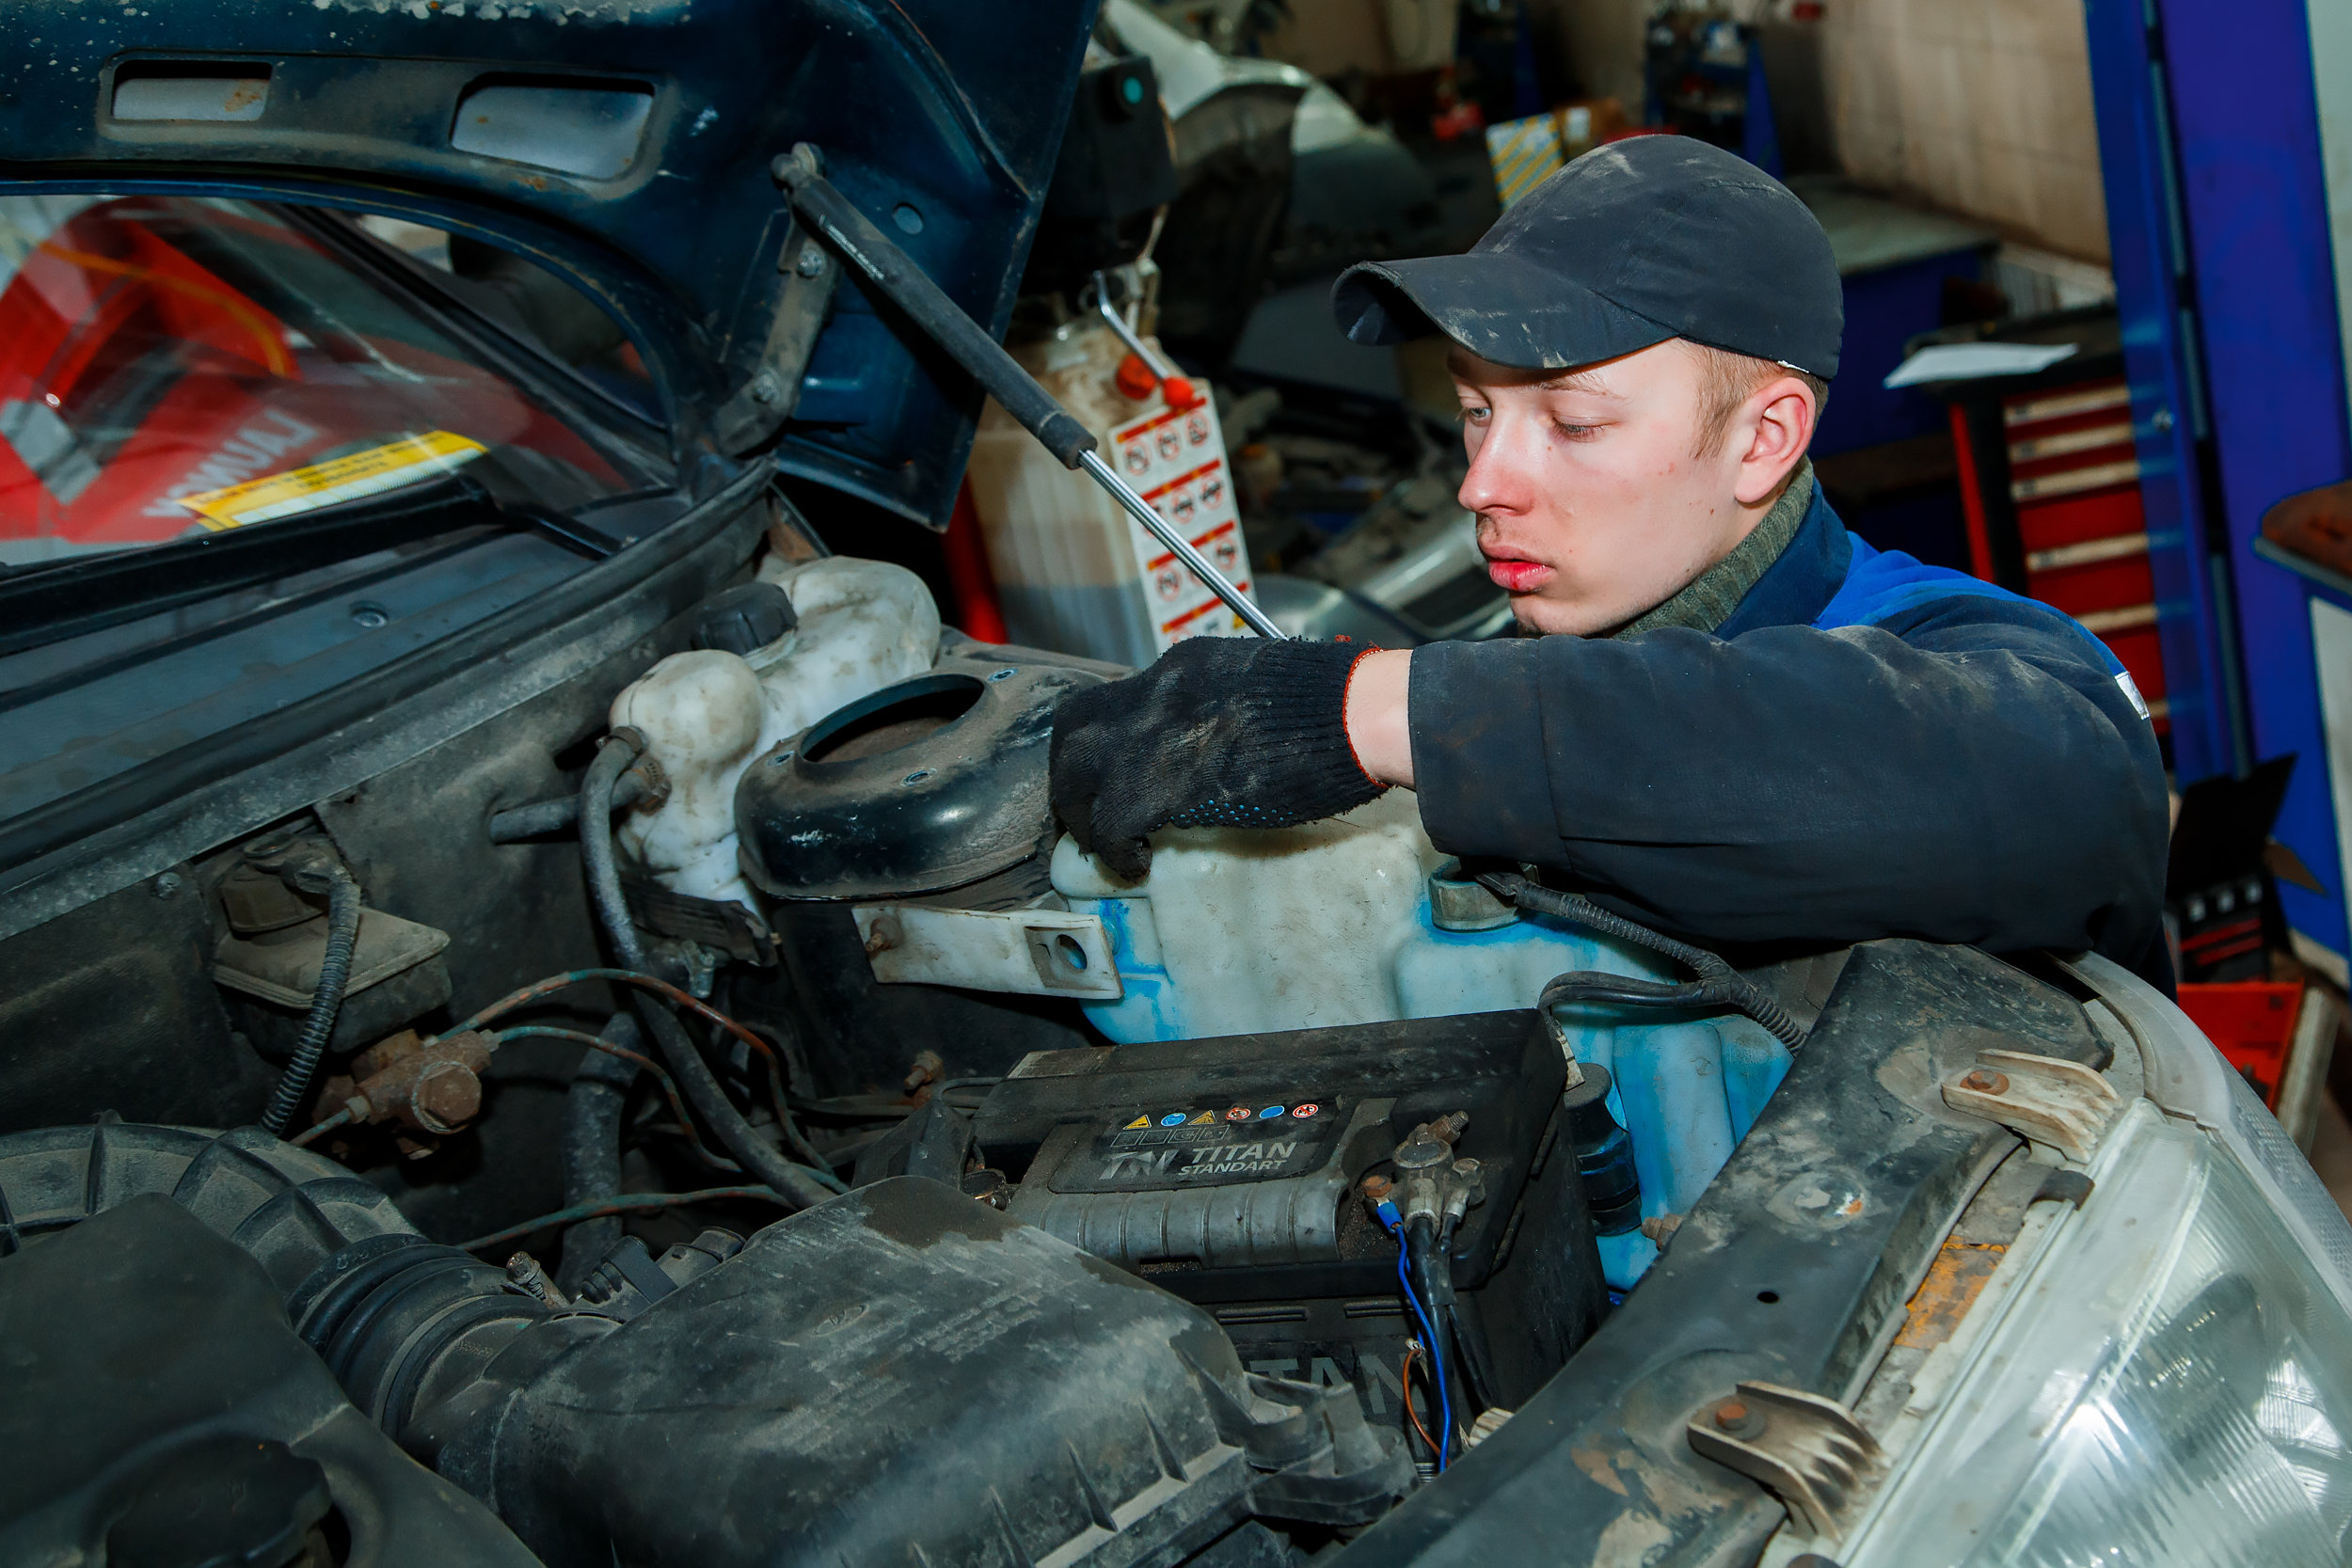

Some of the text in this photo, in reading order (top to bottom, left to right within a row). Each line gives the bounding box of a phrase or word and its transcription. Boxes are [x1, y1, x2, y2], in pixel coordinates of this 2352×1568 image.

[1190, 1141, 1297, 1164] TITAN
[1178, 1160, 1288, 1177] STANDART
[1248, 1353, 1427, 1415] TAN
